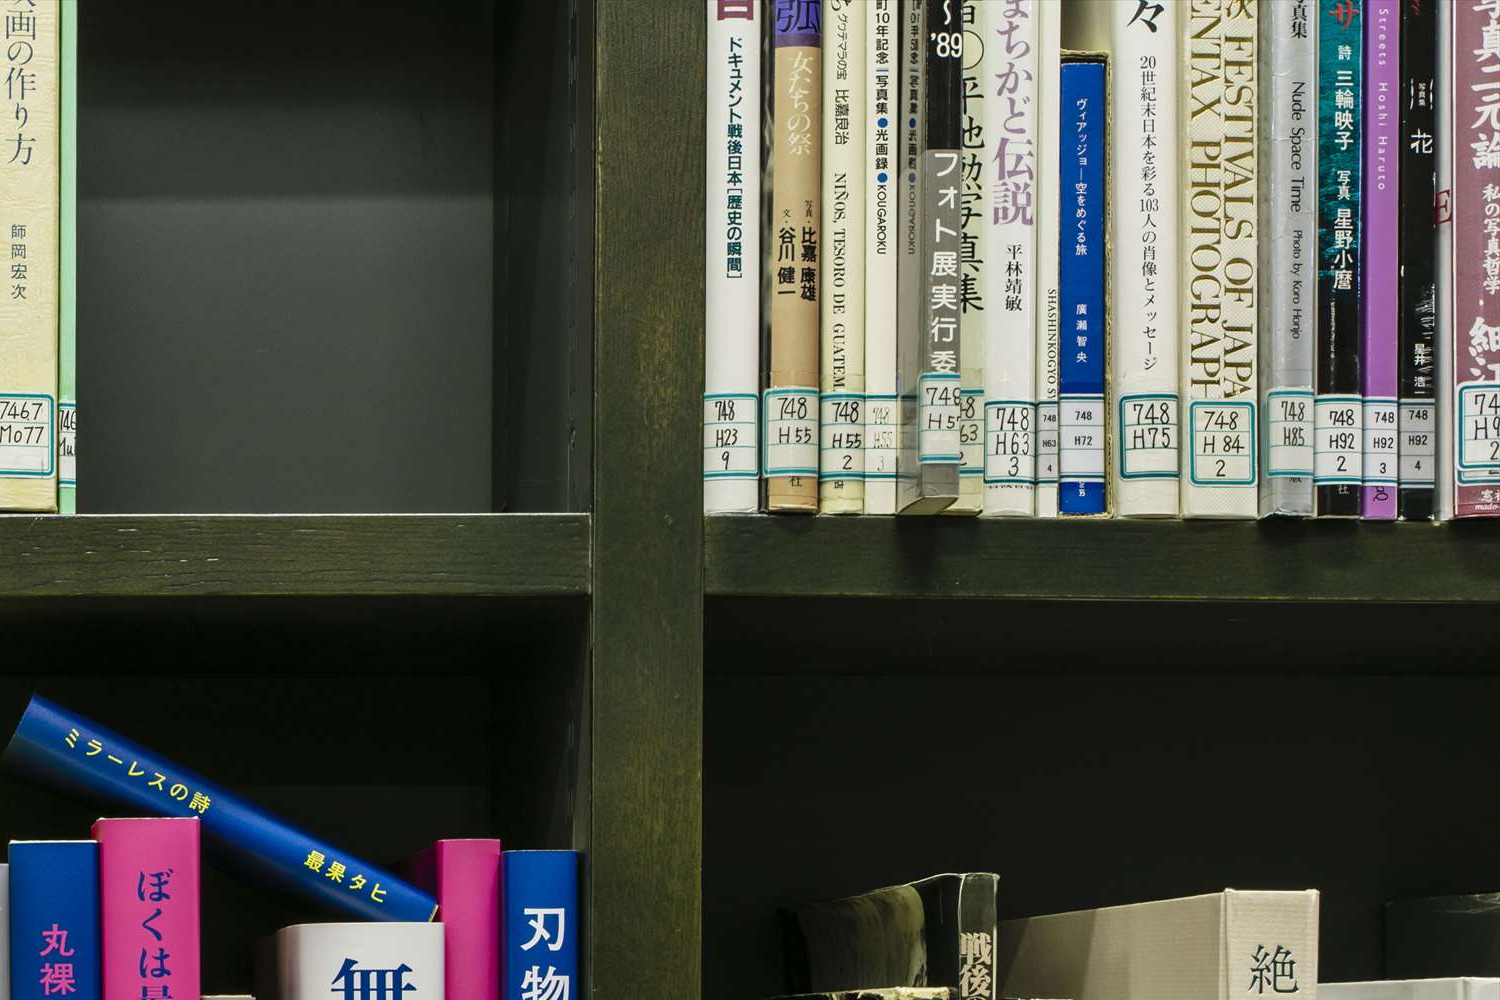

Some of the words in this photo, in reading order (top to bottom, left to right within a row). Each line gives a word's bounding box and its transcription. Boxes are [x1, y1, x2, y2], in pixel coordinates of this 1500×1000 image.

[1378, 8, 1389, 66] Streets
[787, 51, 813, 156] 女たちの祭
[1290, 82, 1306, 121] Nude
[1334, 71, 1354, 151] 三輪映子
[1223, 36, 1254, 241] FESTIVALS
[1290, 127, 1306, 170] Space
[1377, 135, 1388, 191] Haruto
[1290, 177, 1302, 213] Time
[1336, 170, 1352, 201] 写真
[876, 184, 886, 255] KOUGAROKU
[10, 224, 27, 299] 師岡宏次
[833, 229, 847, 288] TESORO
[1005, 243, 1023, 312] 平林靖敏
[1223, 257, 1253, 297] OF
[833, 294, 846, 314] DE
[832, 323, 846, 392] GUATEM
[1074, 435, 1092, 446] H72
[1132, 405, 1170, 425] 748
[1132, 429, 1171, 448] H75
[64, 728, 211, 815] ミラーレスの詩
[303, 849, 387, 903] 最果タヒ
